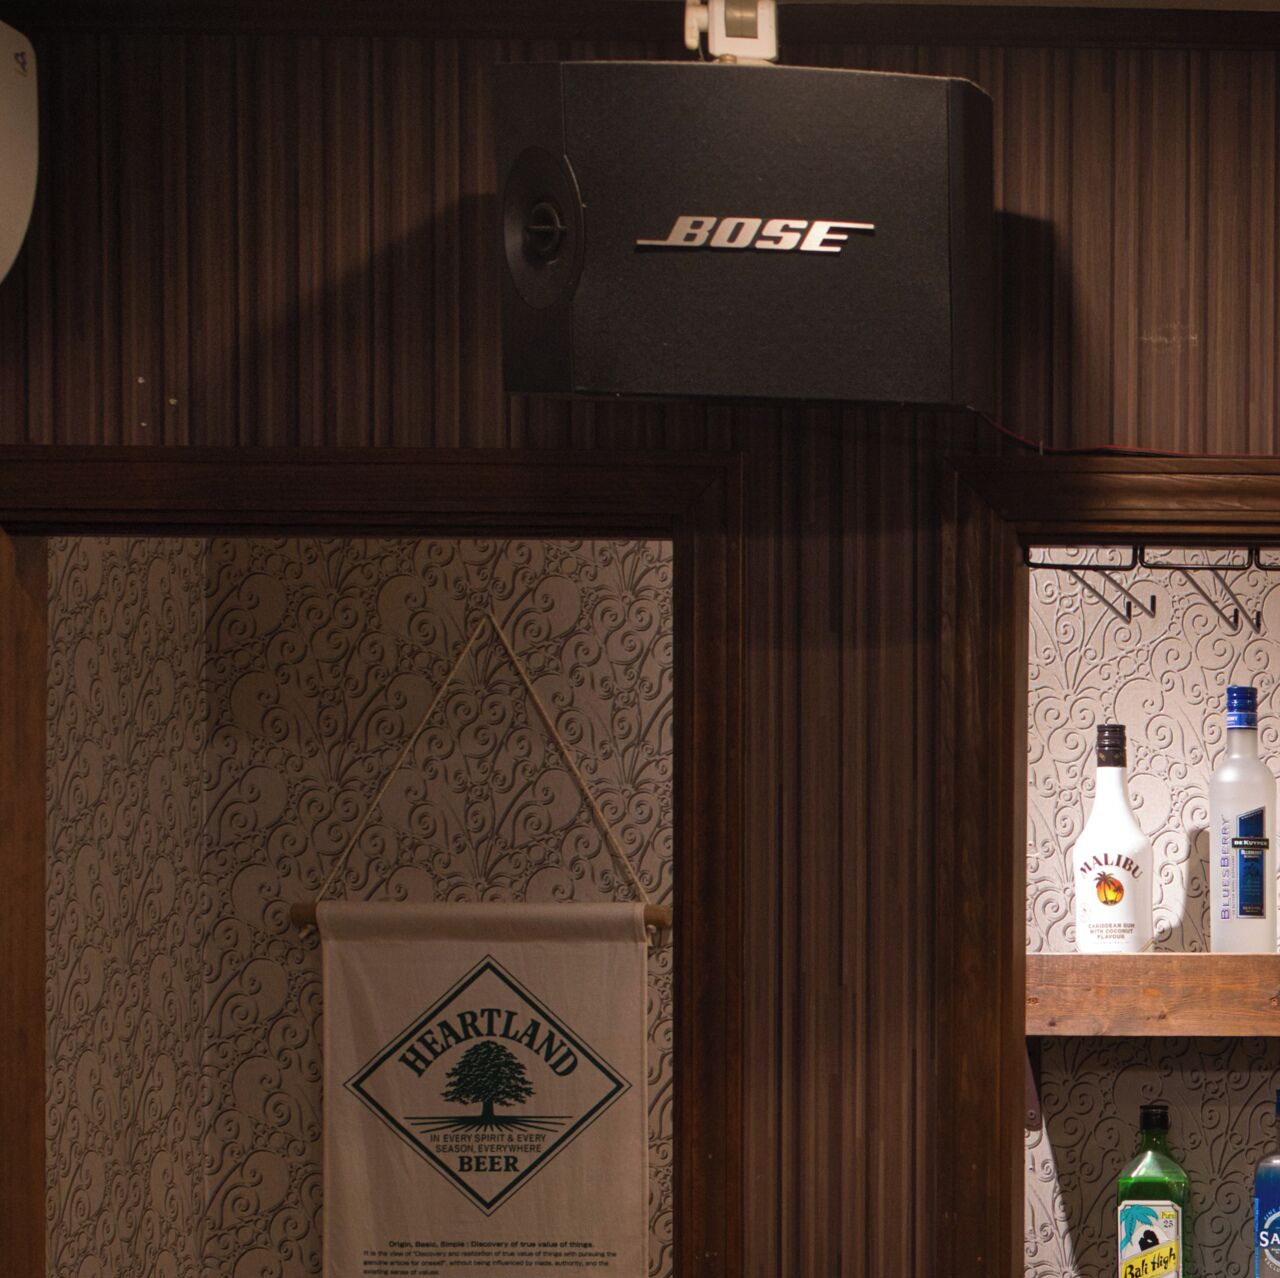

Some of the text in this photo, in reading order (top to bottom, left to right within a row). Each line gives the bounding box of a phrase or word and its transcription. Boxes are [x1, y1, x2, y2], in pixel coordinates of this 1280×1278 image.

[637, 216, 875, 252] BOSE
[1080, 853, 1143, 879] MALIBU
[398, 1008, 579, 1078] HEARTLAND
[430, 1134, 546, 1142] IN EVERY SPIRIT & EVERY
[436, 1144, 542, 1153] SEASON, EVERYWHERE
[458, 1155, 520, 1172] BEER
[1163, 1220, 1174, 1228] 25
[1150, 1247, 1177, 1271] High
